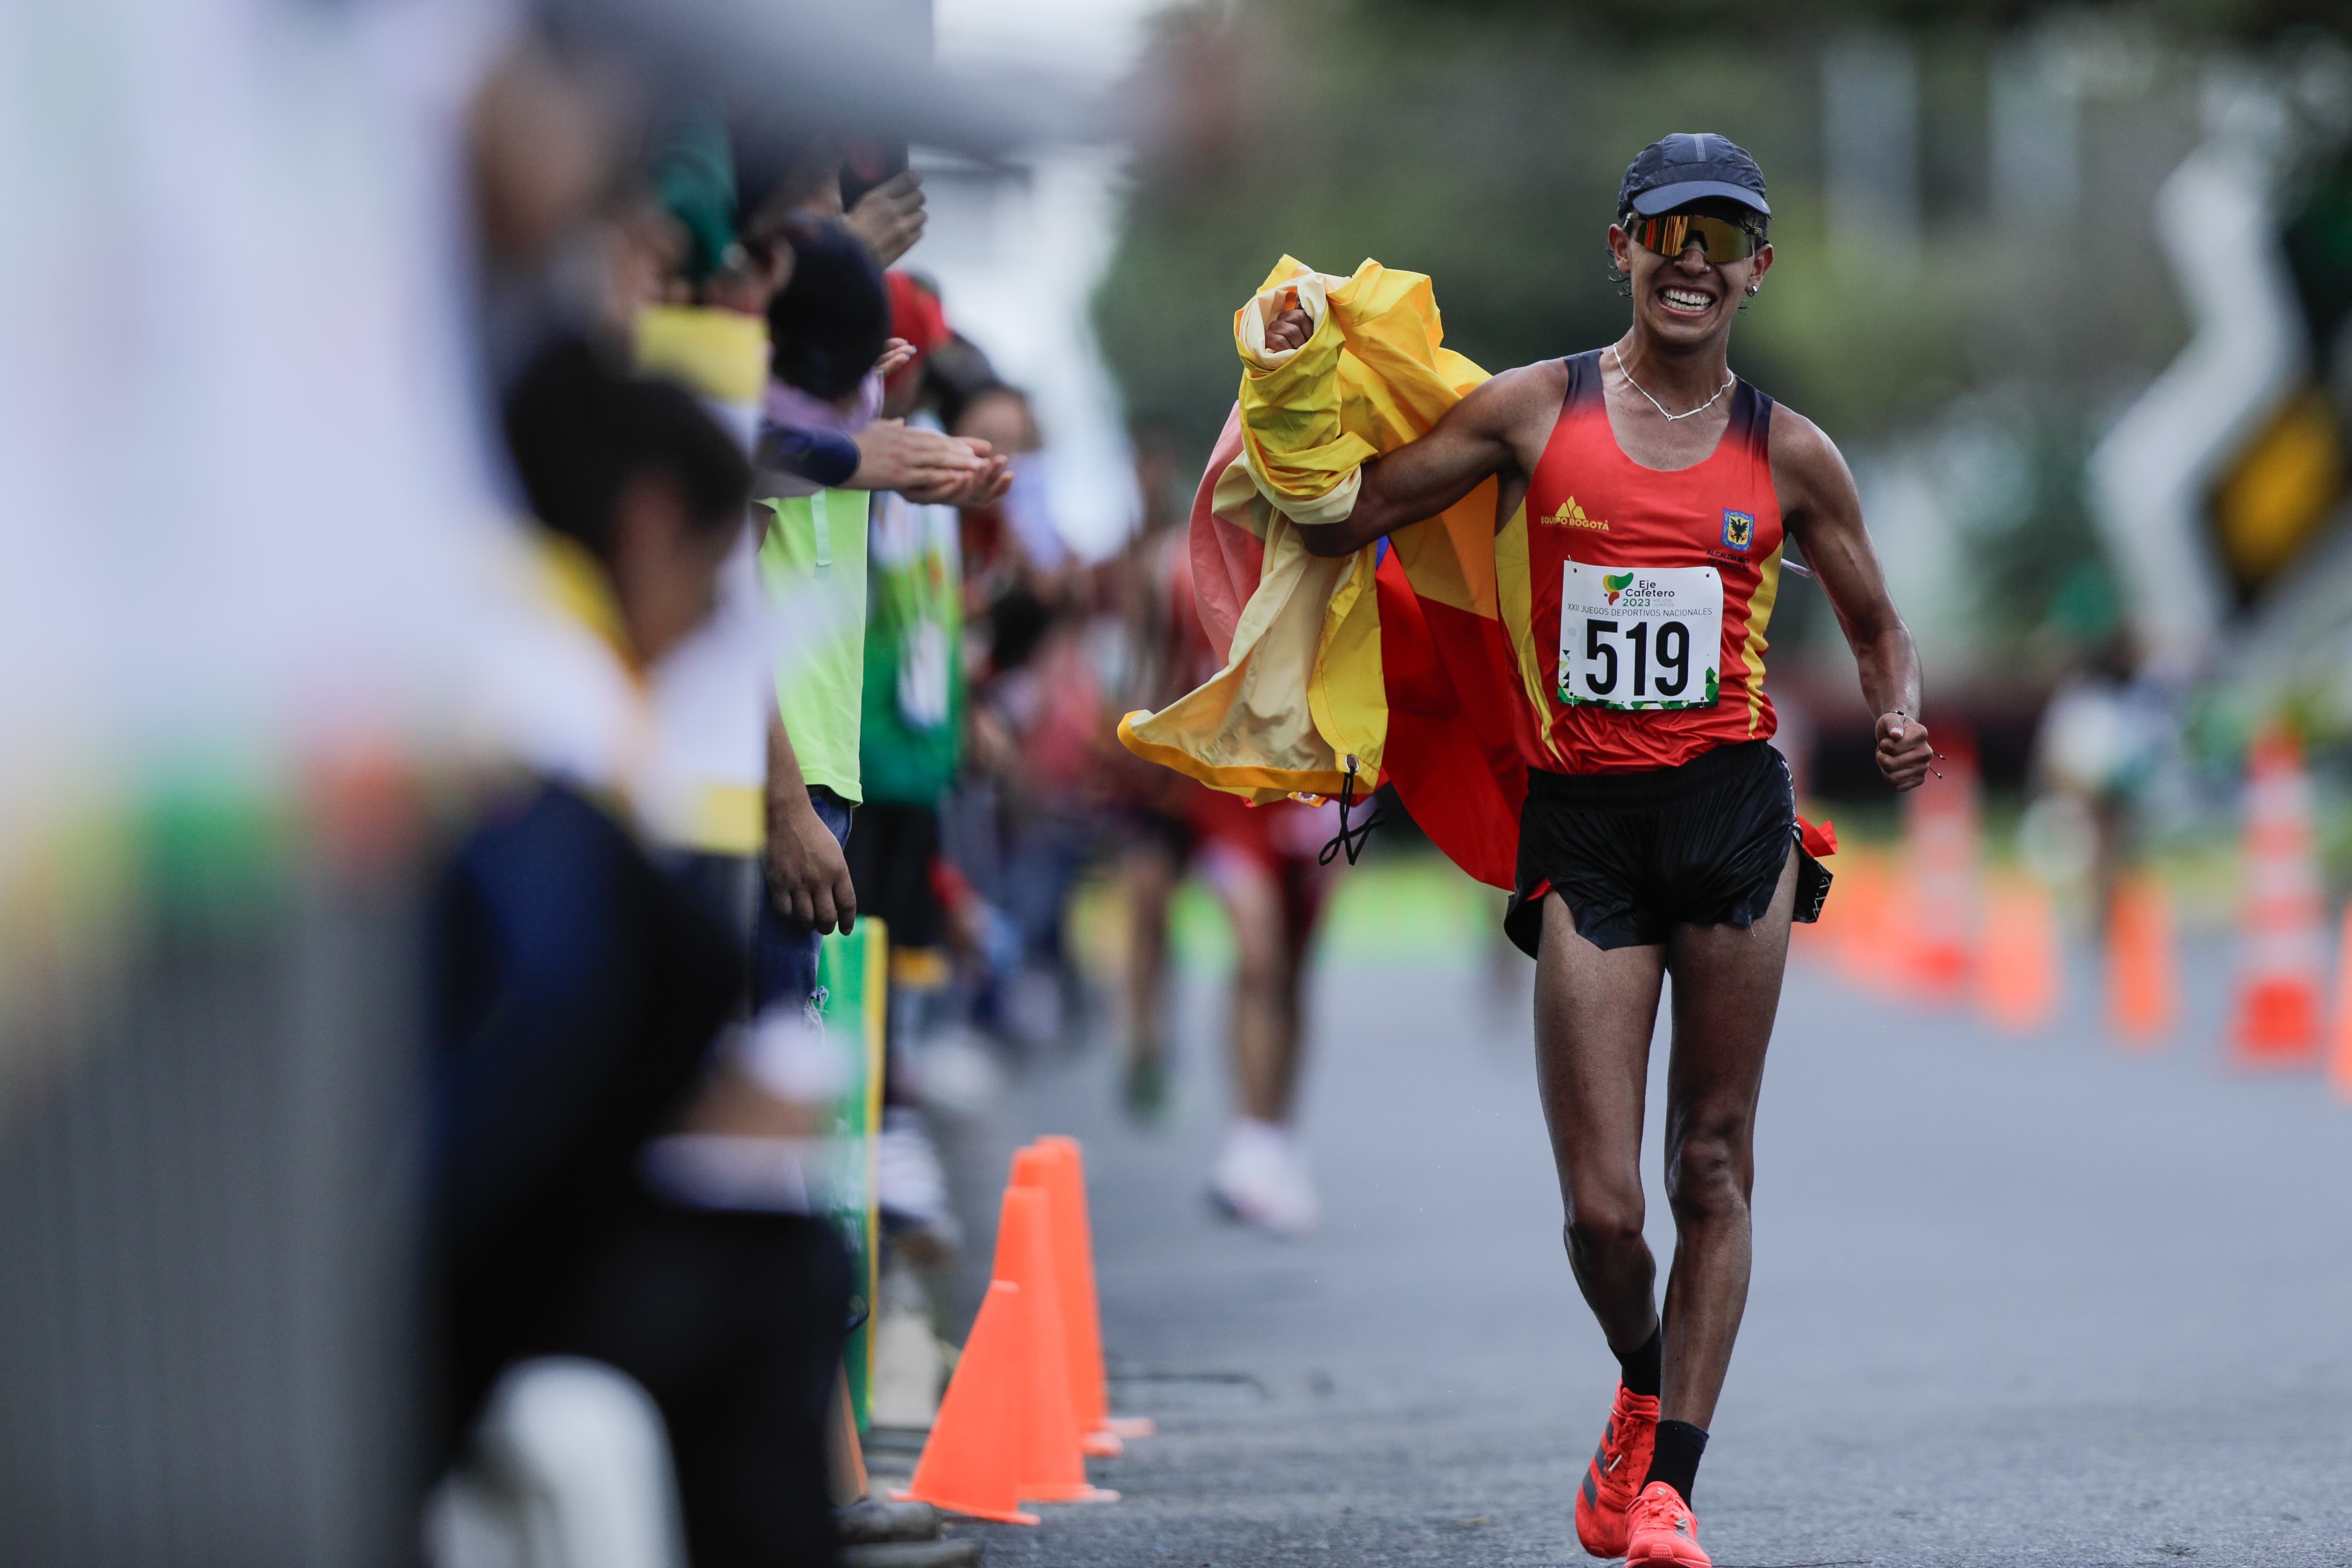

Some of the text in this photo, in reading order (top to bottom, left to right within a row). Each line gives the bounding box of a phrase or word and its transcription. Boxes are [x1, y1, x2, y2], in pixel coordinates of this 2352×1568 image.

[1541, 516, 1568, 525] EQUIPO
[1639, 580, 1656, 590] Eje
[1625, 588, 1675, 597] Cafetero
[1622, 598, 1651, 607] 2023
[1567, 602, 1713, 617] XXII JUEGOS DEPORTIVOS NACIONALES
[1585, 618, 1691, 697] 519
